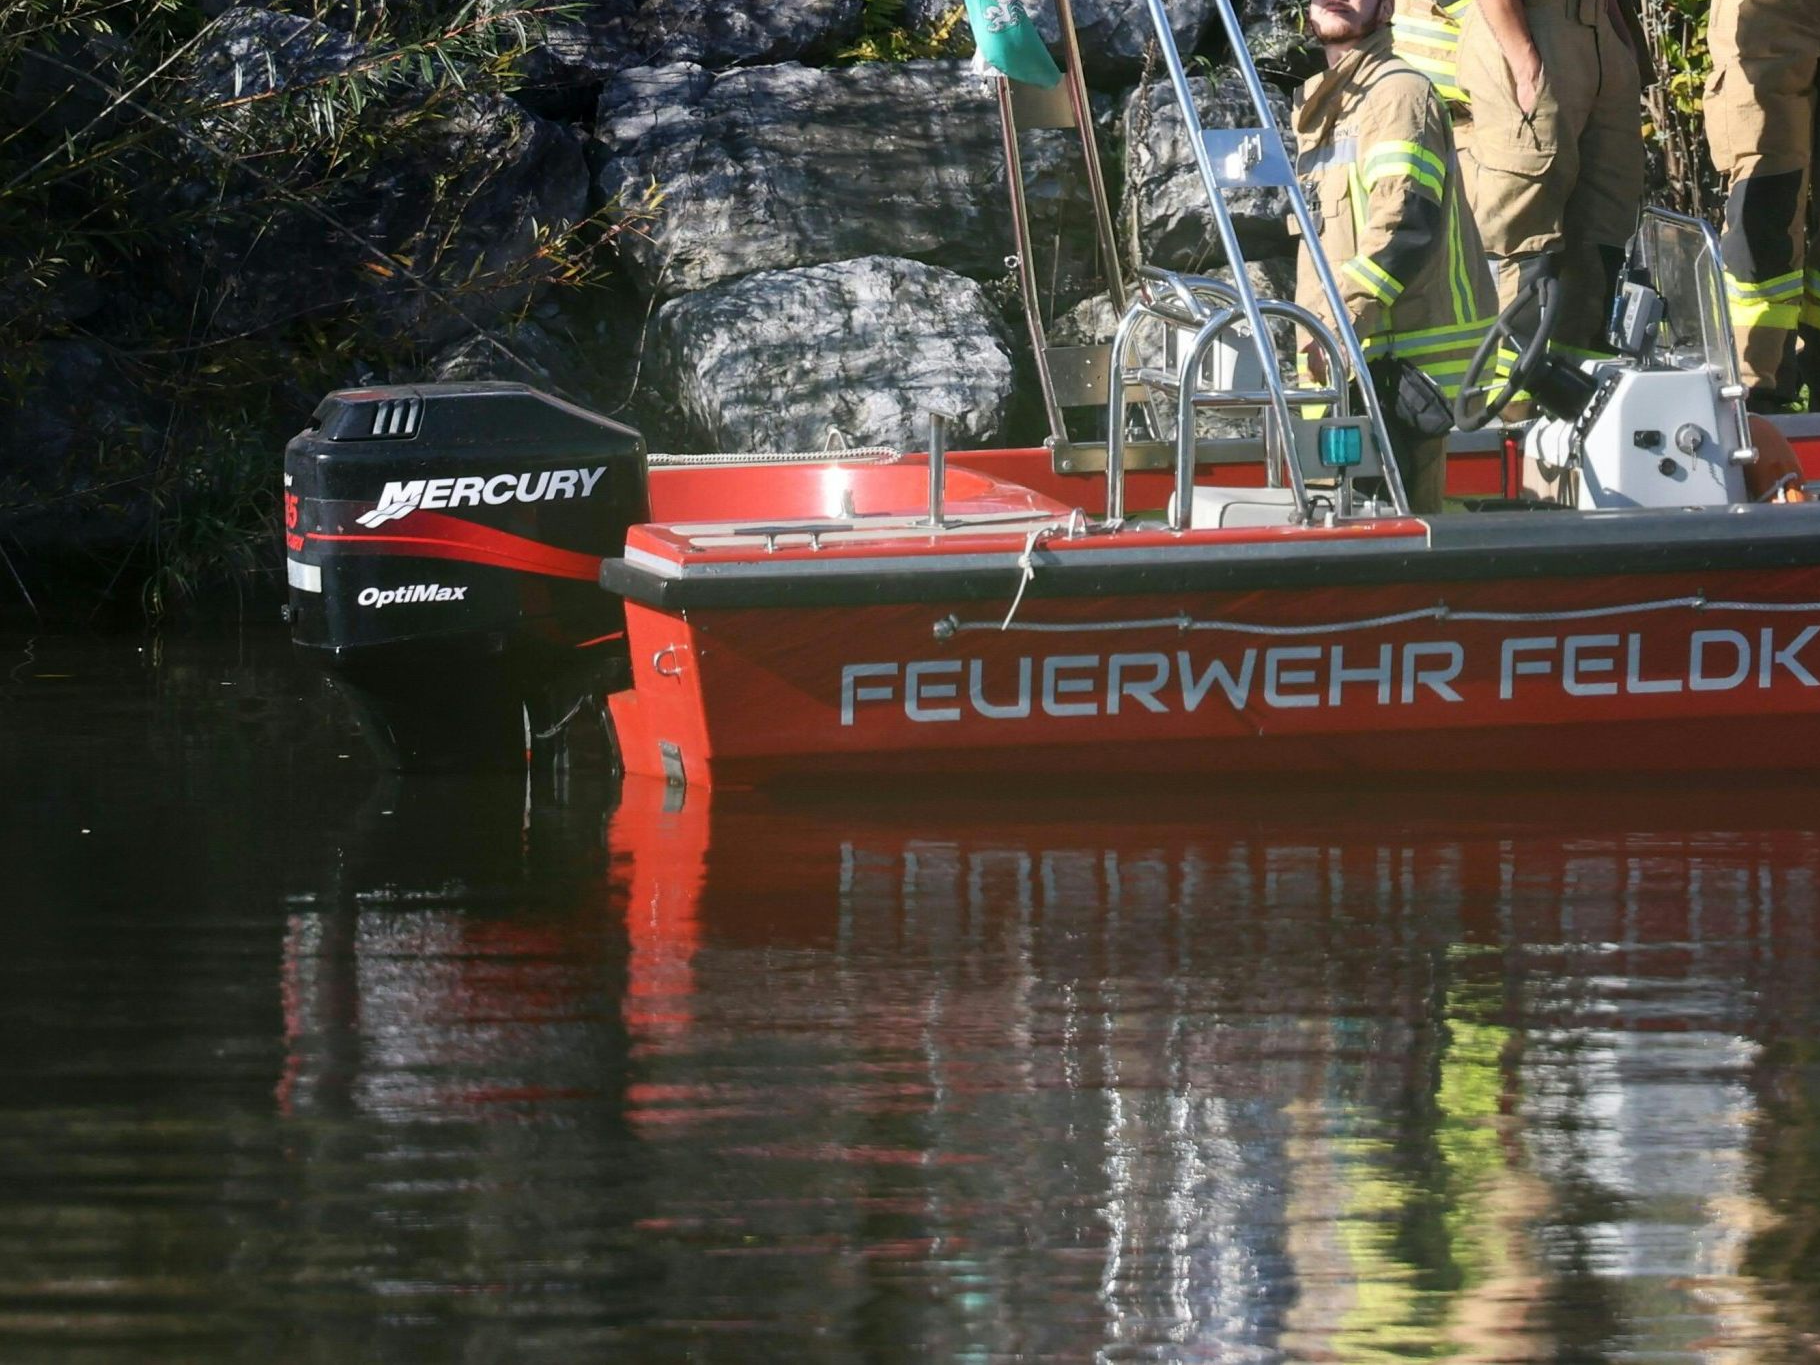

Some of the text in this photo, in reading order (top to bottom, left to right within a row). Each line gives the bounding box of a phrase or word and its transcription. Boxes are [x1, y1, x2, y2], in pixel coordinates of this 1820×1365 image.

[356, 467, 607, 528] MERCURY
[357, 584, 468, 608] OptiMax
[841, 640, 1464, 726] FEUERWEHR
